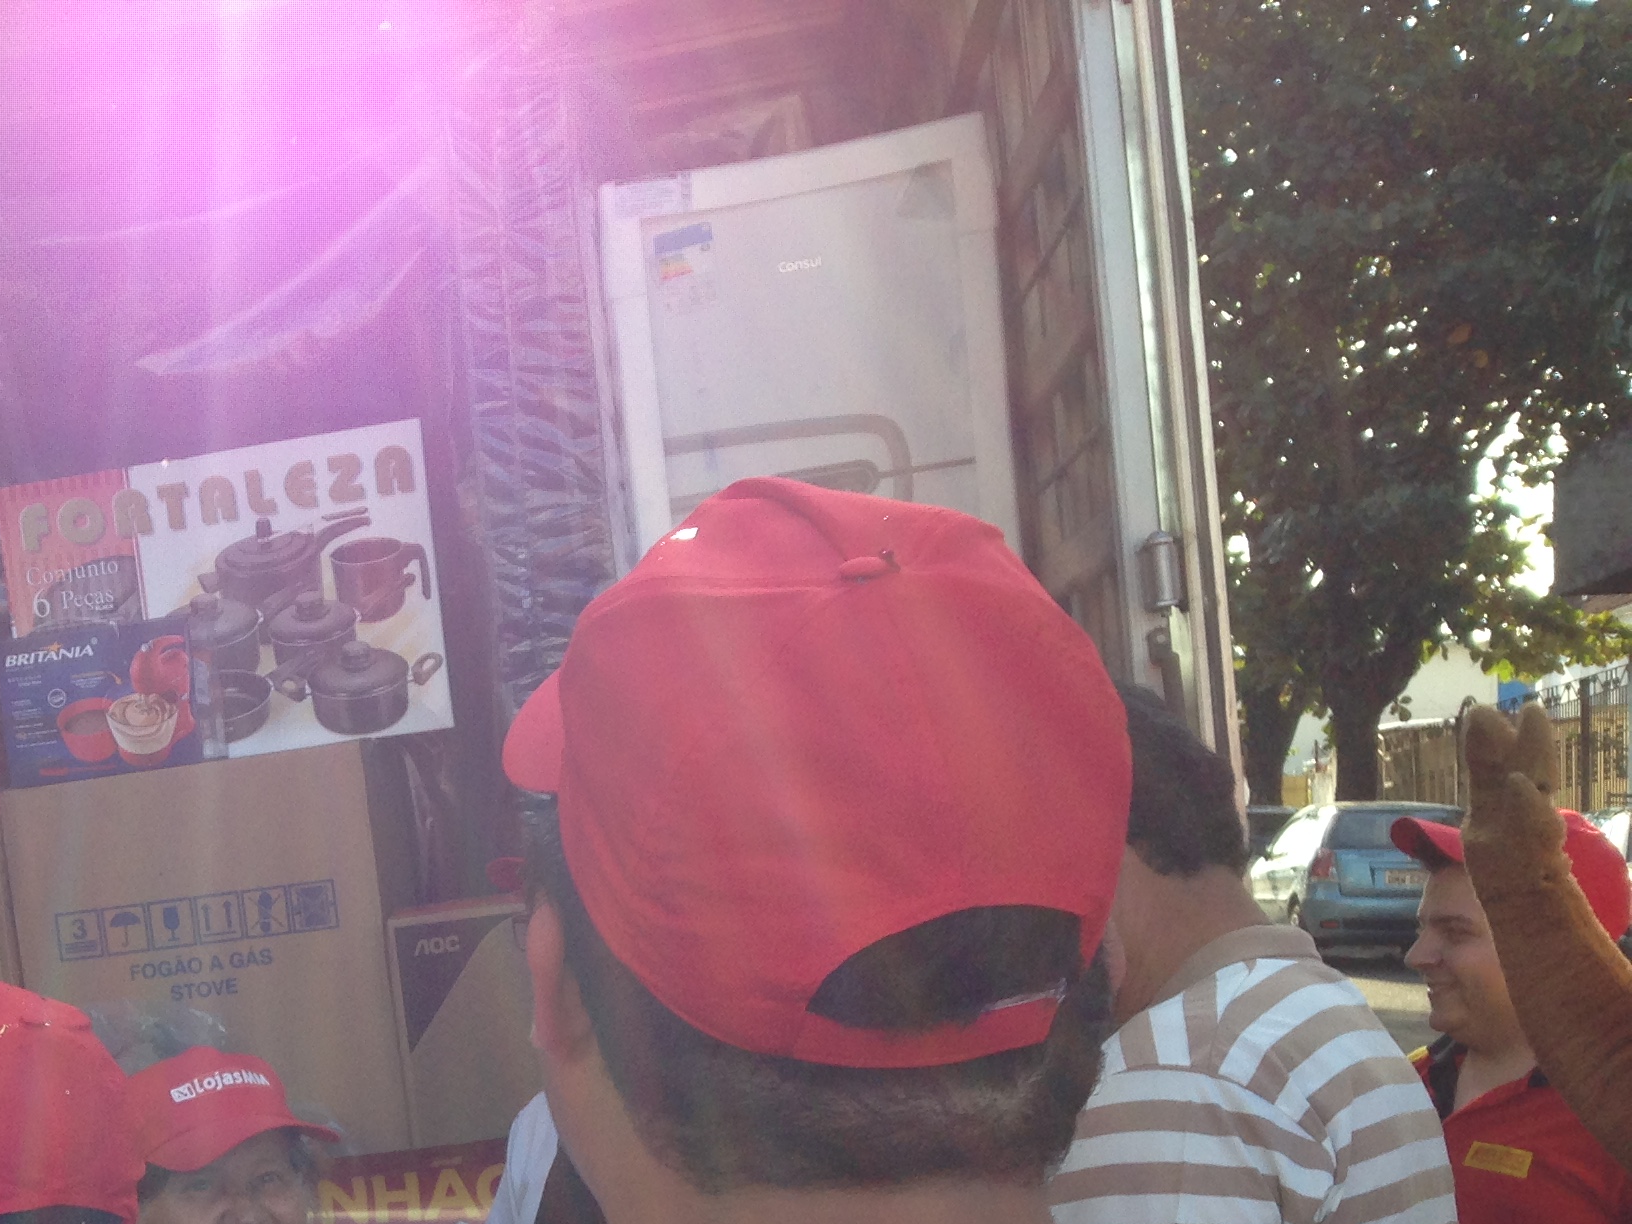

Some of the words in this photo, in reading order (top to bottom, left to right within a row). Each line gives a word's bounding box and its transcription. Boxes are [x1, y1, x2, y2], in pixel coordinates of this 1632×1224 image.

[778, 256, 822, 273] Consul
[19, 444, 416, 553] FORTALEZA
[26, 559, 119, 587] Conjunto
[32, 587, 51, 618] 6
[61, 587, 114, 610] Peças
[72, 918, 88, 940] 3
[414, 935, 460, 957] AOC
[130, 955, 202, 981] FOGÃO
[209, 955, 224, 972] A
[229, 945, 273, 969] GÁS
[170, 977, 238, 1001] STOVE
[193, 1069, 270, 1094] LojasMM
